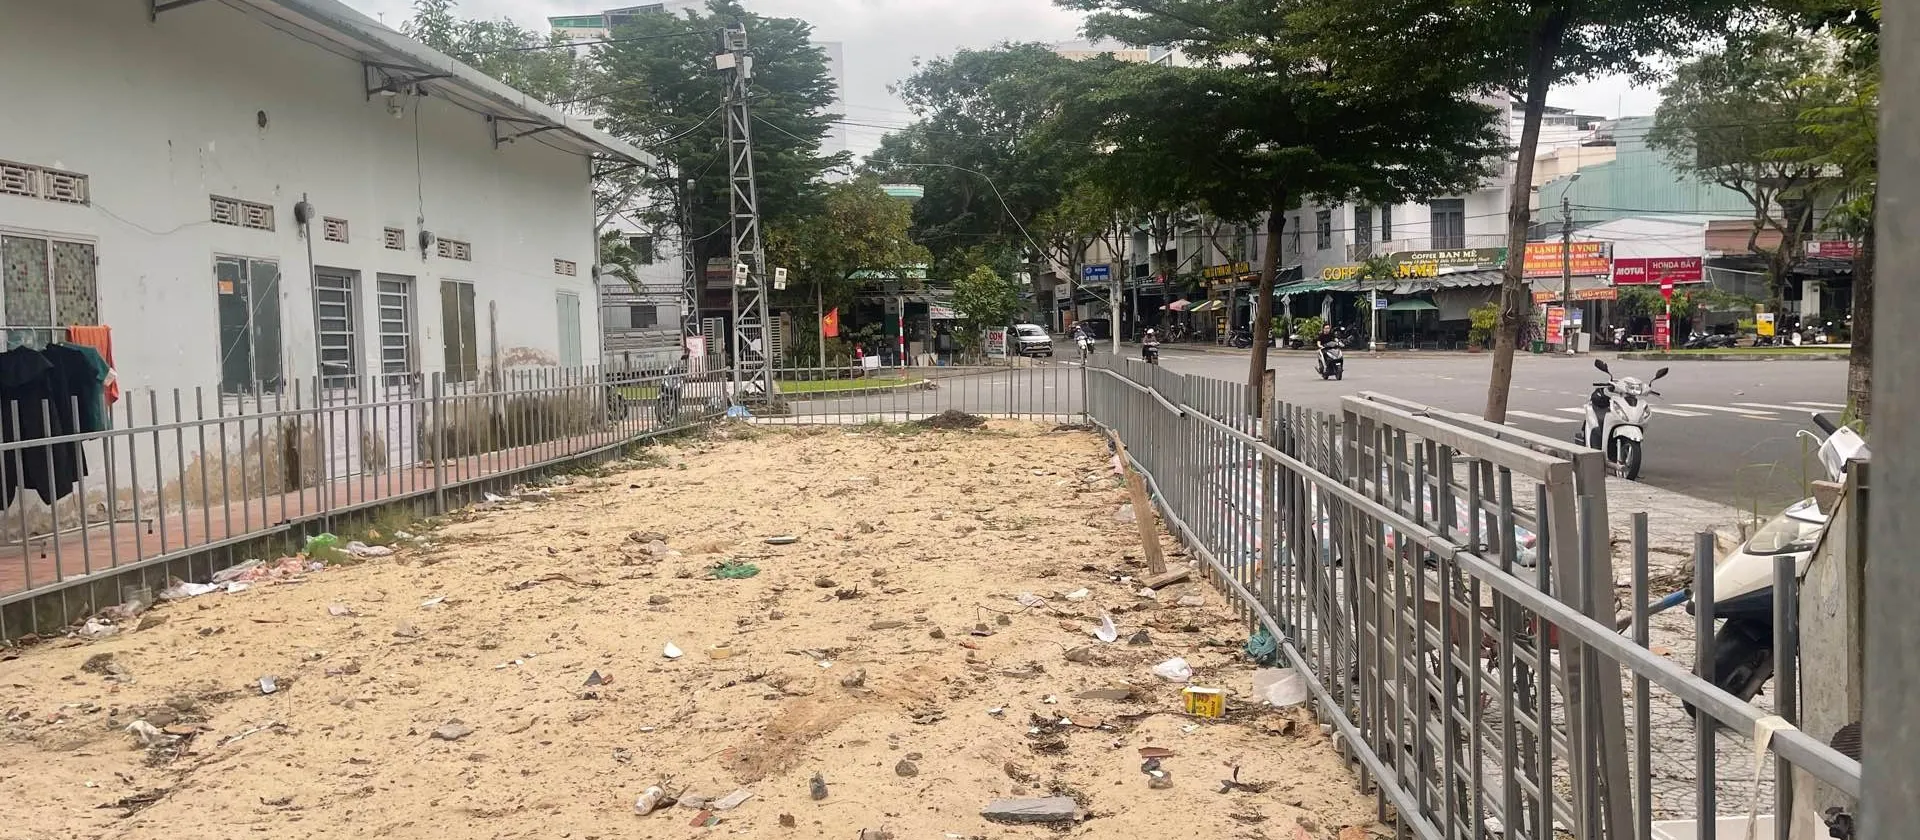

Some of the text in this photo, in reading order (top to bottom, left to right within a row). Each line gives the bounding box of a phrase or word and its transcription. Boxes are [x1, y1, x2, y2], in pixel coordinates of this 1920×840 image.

[1411, 249, 1477, 260] COFFEE BAN MÊ
[1652, 261, 1679, 269] HONDA
[1616, 267, 1645, 276] MOTUL
